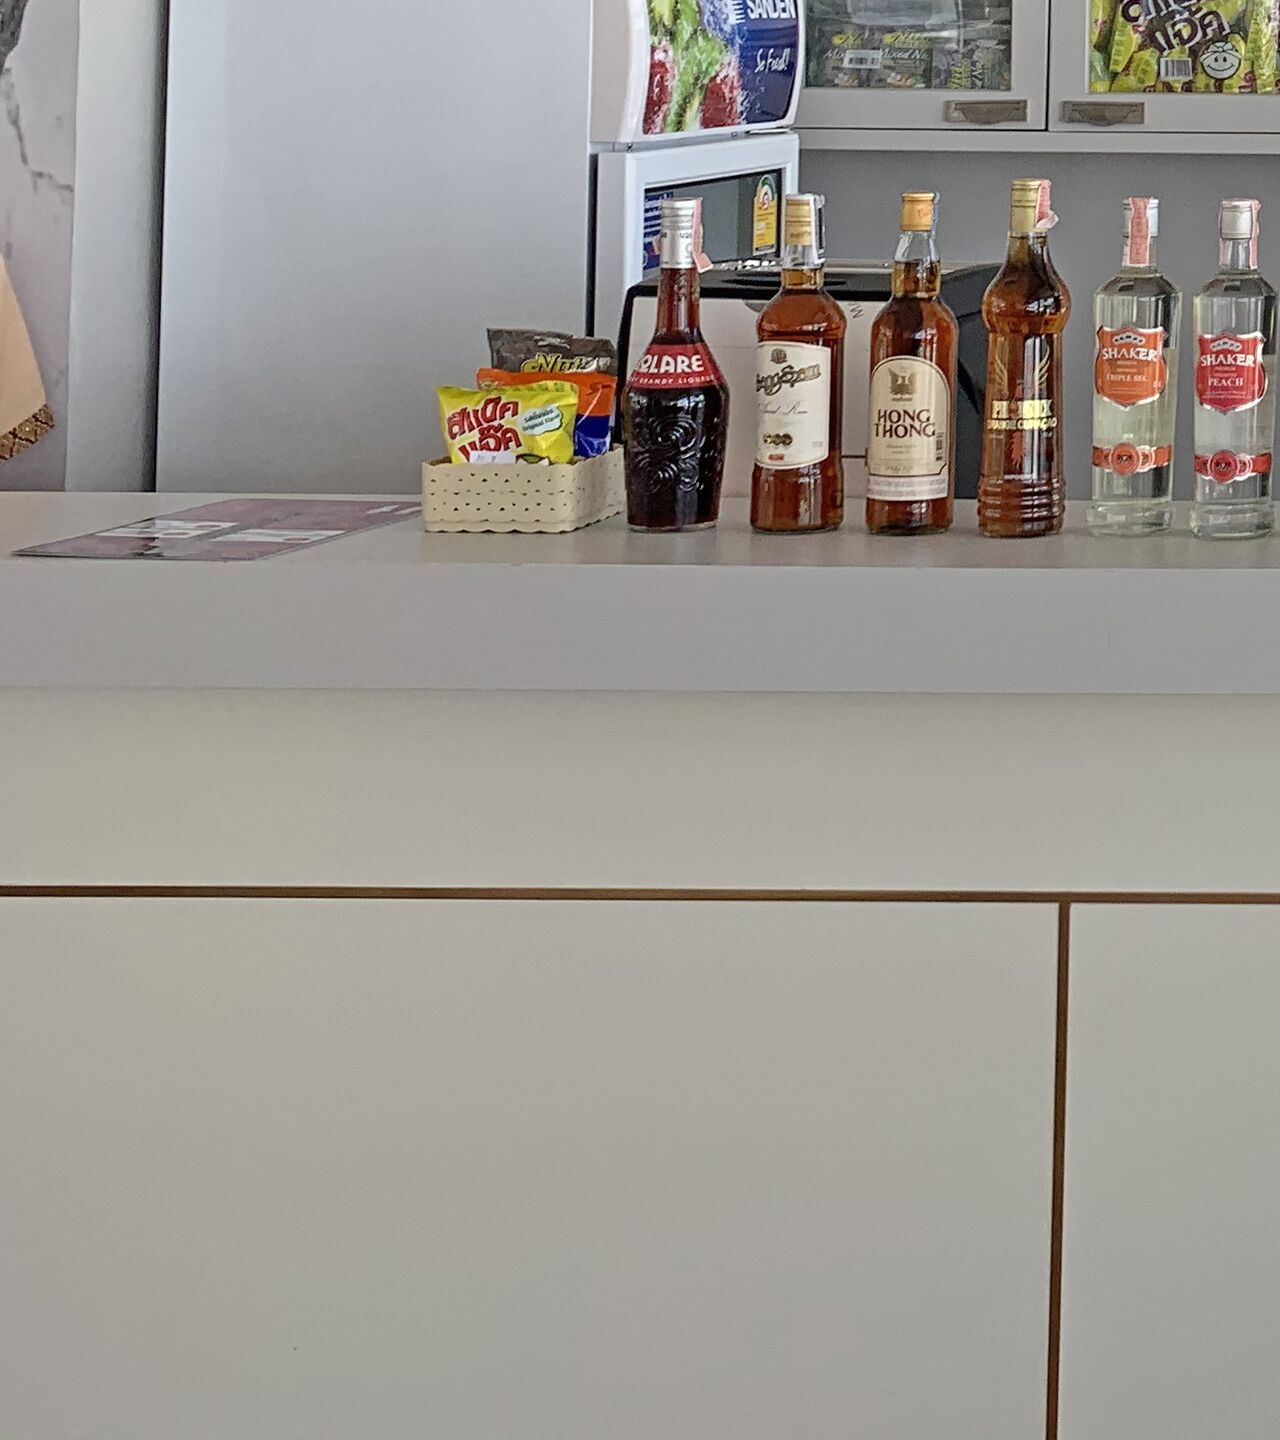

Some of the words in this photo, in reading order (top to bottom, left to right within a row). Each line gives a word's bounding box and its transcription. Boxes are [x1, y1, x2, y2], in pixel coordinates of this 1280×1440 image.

[1102, 347, 1158, 362] SHAKER
[1200, 353, 1256, 367] SHAKER
[640, 354, 705, 374] OLARE
[1208, 377, 1244, 387] PEACH
[877, 409, 930, 425] HONG
[874, 423, 936, 438] THONG
